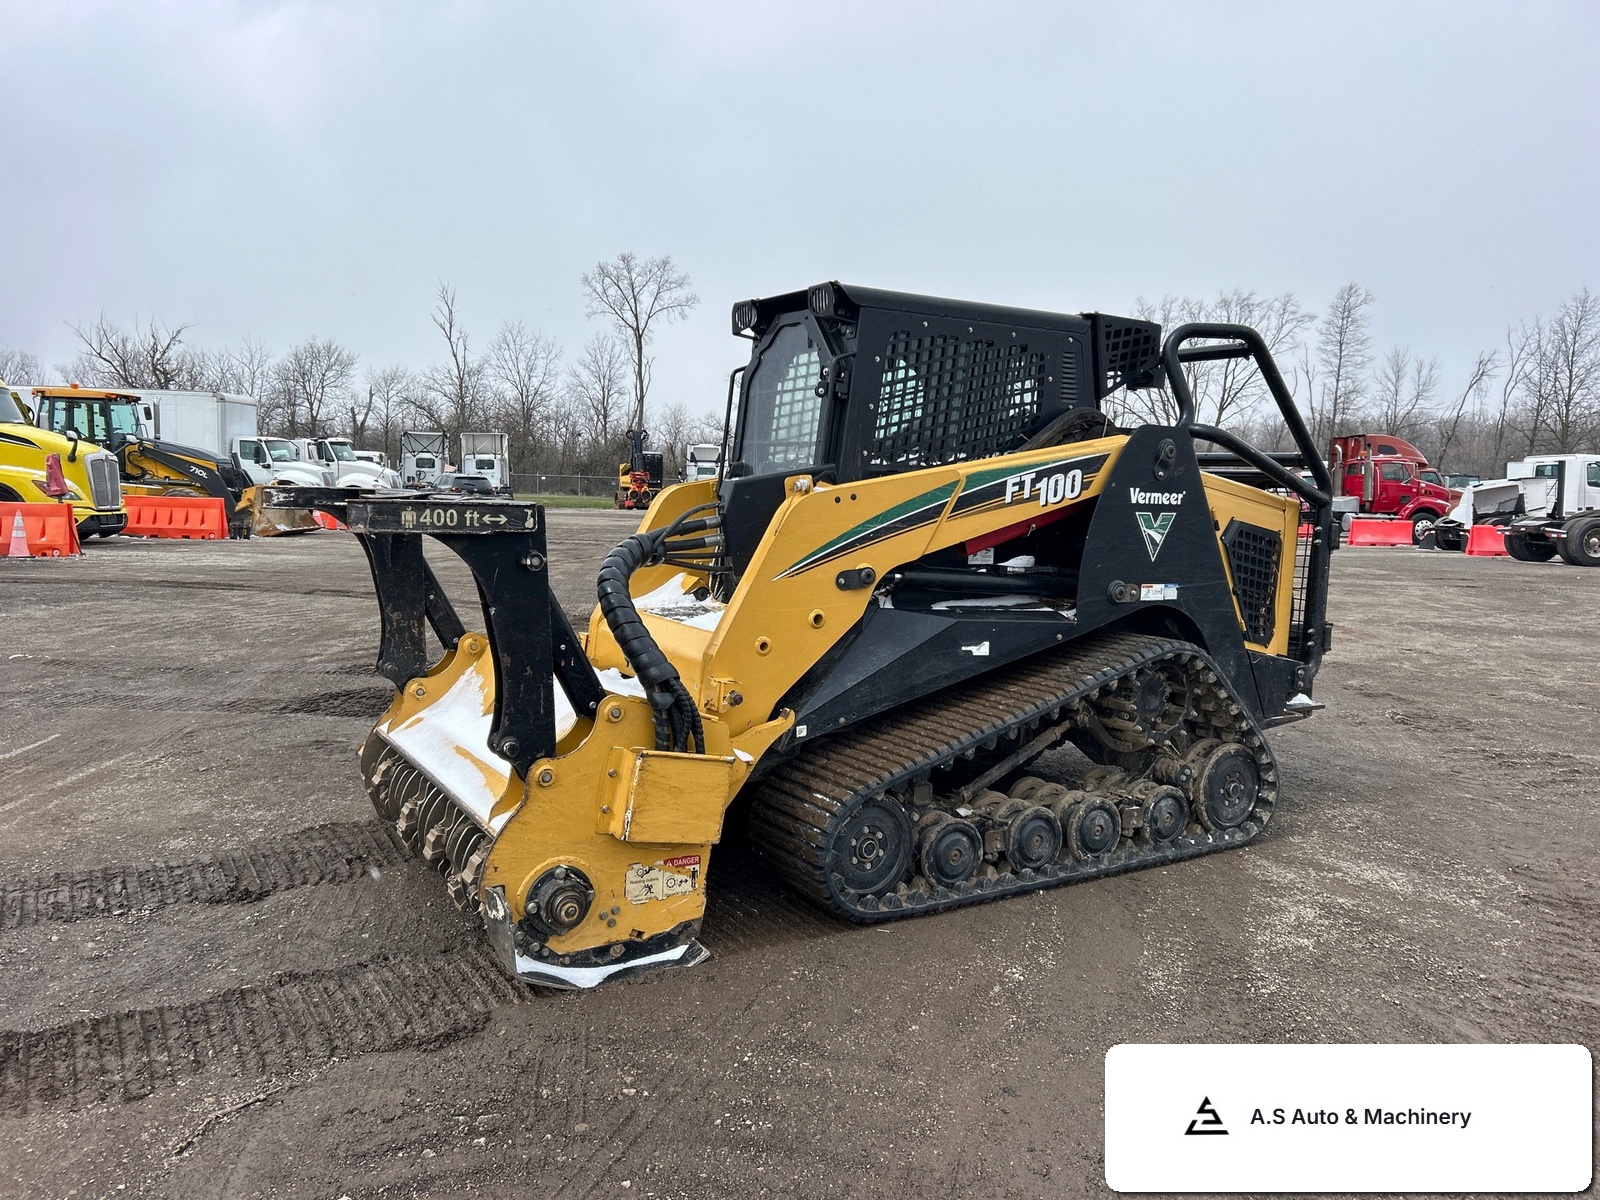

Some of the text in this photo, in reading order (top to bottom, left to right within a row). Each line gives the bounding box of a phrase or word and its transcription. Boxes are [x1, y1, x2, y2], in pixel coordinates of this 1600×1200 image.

[190, 465, 208, 479] 710L
[1129, 487, 1184, 505] Vermeer
[419, 508, 480, 527] 400 ft
[673, 856, 700, 867] DANGER
